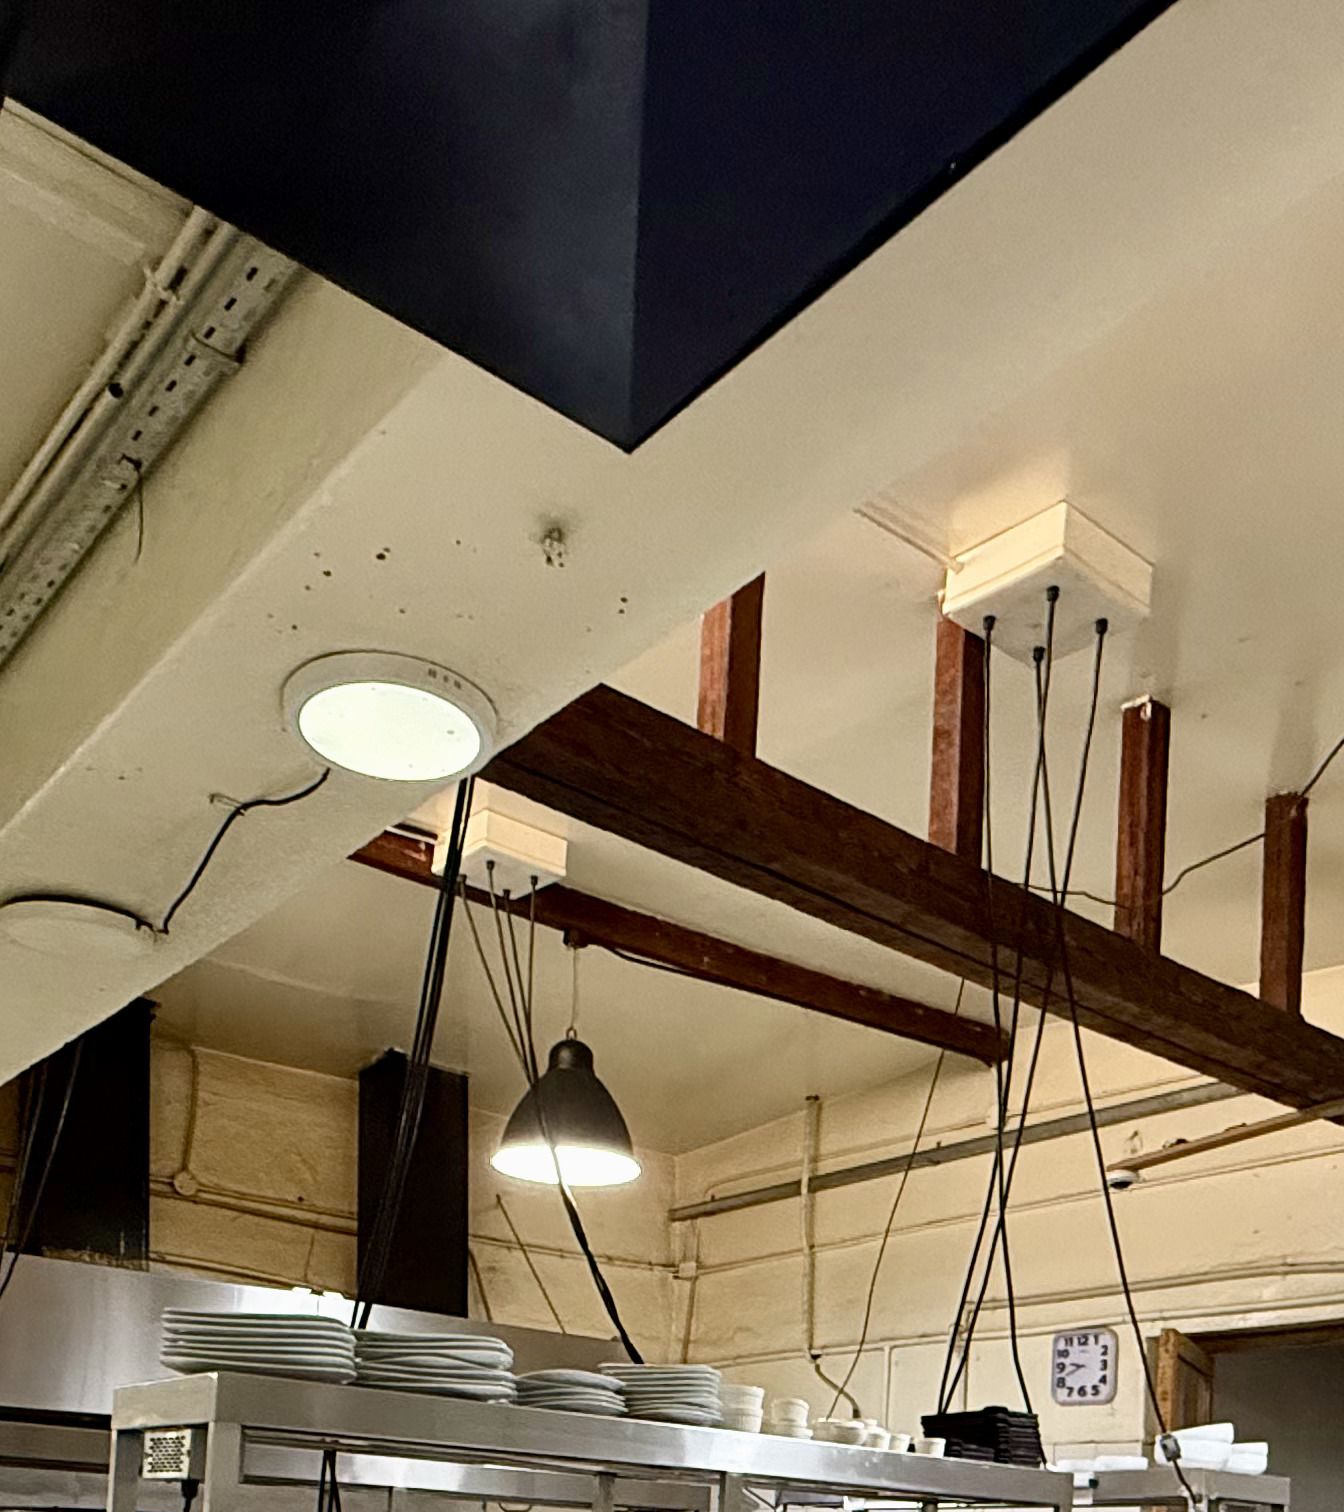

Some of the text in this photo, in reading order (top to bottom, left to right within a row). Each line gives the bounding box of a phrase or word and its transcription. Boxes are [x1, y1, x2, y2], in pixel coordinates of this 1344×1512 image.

[1077, 1335, 1089, 1346] 12
[1093, 1334, 1099, 1345] 1
[1100, 1344, 1108, 1356] 2
[1056, 1362, 1066, 1374] 9
[1100, 1359, 1108, 1371] 3
[1056, 1376, 1066, 1389] 8
[1098, 1373, 1107, 1386] 4
[1066, 1386, 1074, 1397] 7
[1077, 1385, 1087, 1397] 6
[1090, 1384, 1100, 1396] 5
